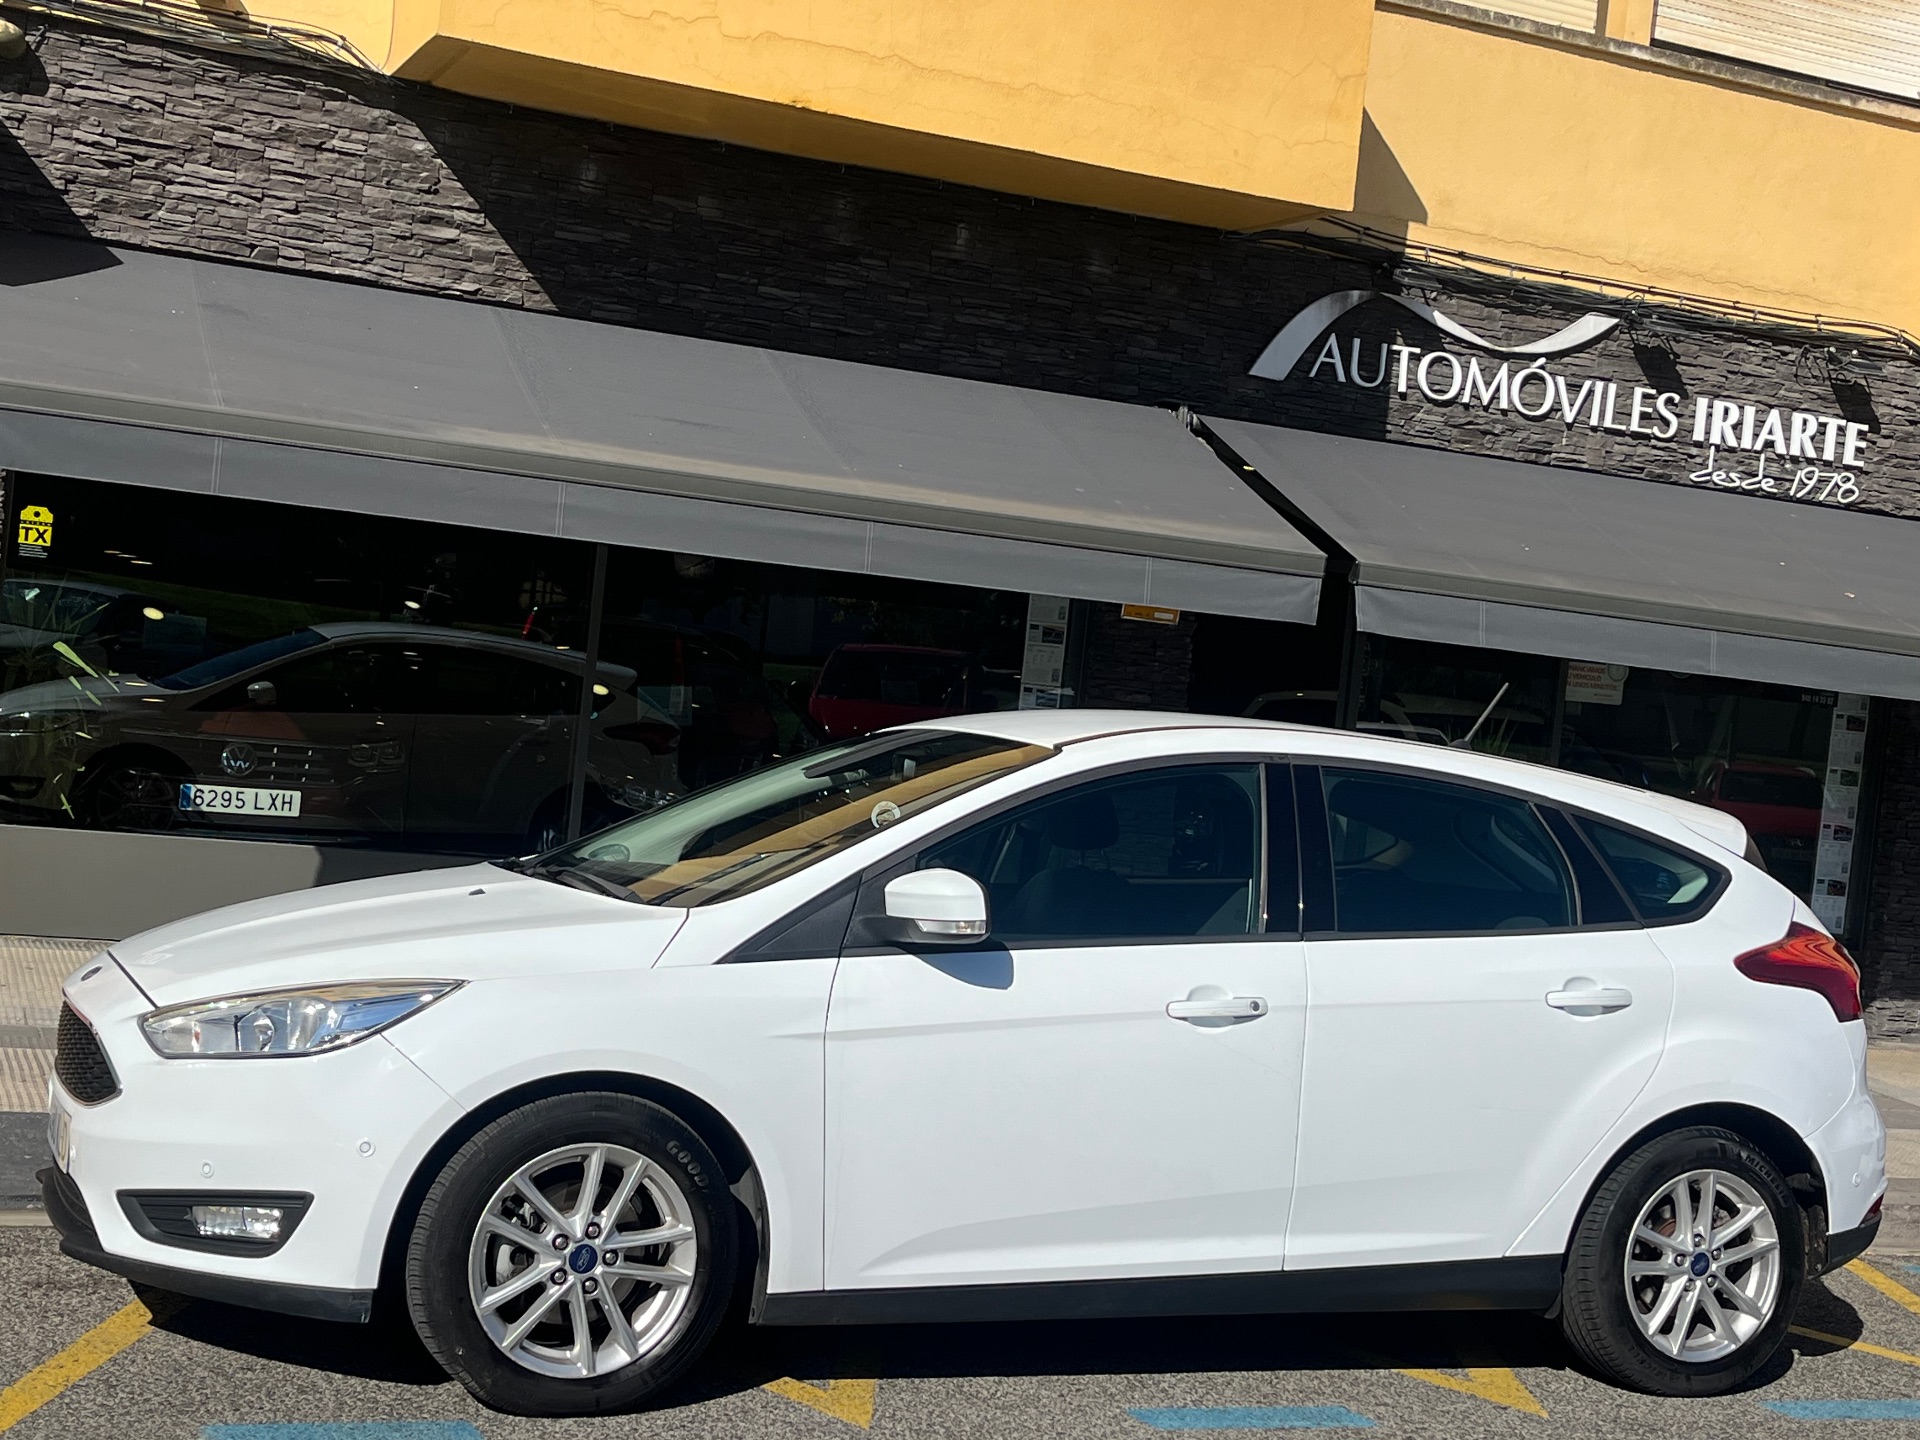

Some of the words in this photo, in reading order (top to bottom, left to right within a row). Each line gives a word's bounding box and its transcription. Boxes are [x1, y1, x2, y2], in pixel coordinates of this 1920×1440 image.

[1308, 332, 1681, 440] AUTOMÓVILES
[1691, 396, 1870, 468] IRIARTE
[1689, 445, 1779, 493] desde
[1789, 466, 1860, 504] 1978
[20, 525, 50, 544] TX
[193, 788, 246, 809] 6295
[253, 791, 293, 812] LXH
